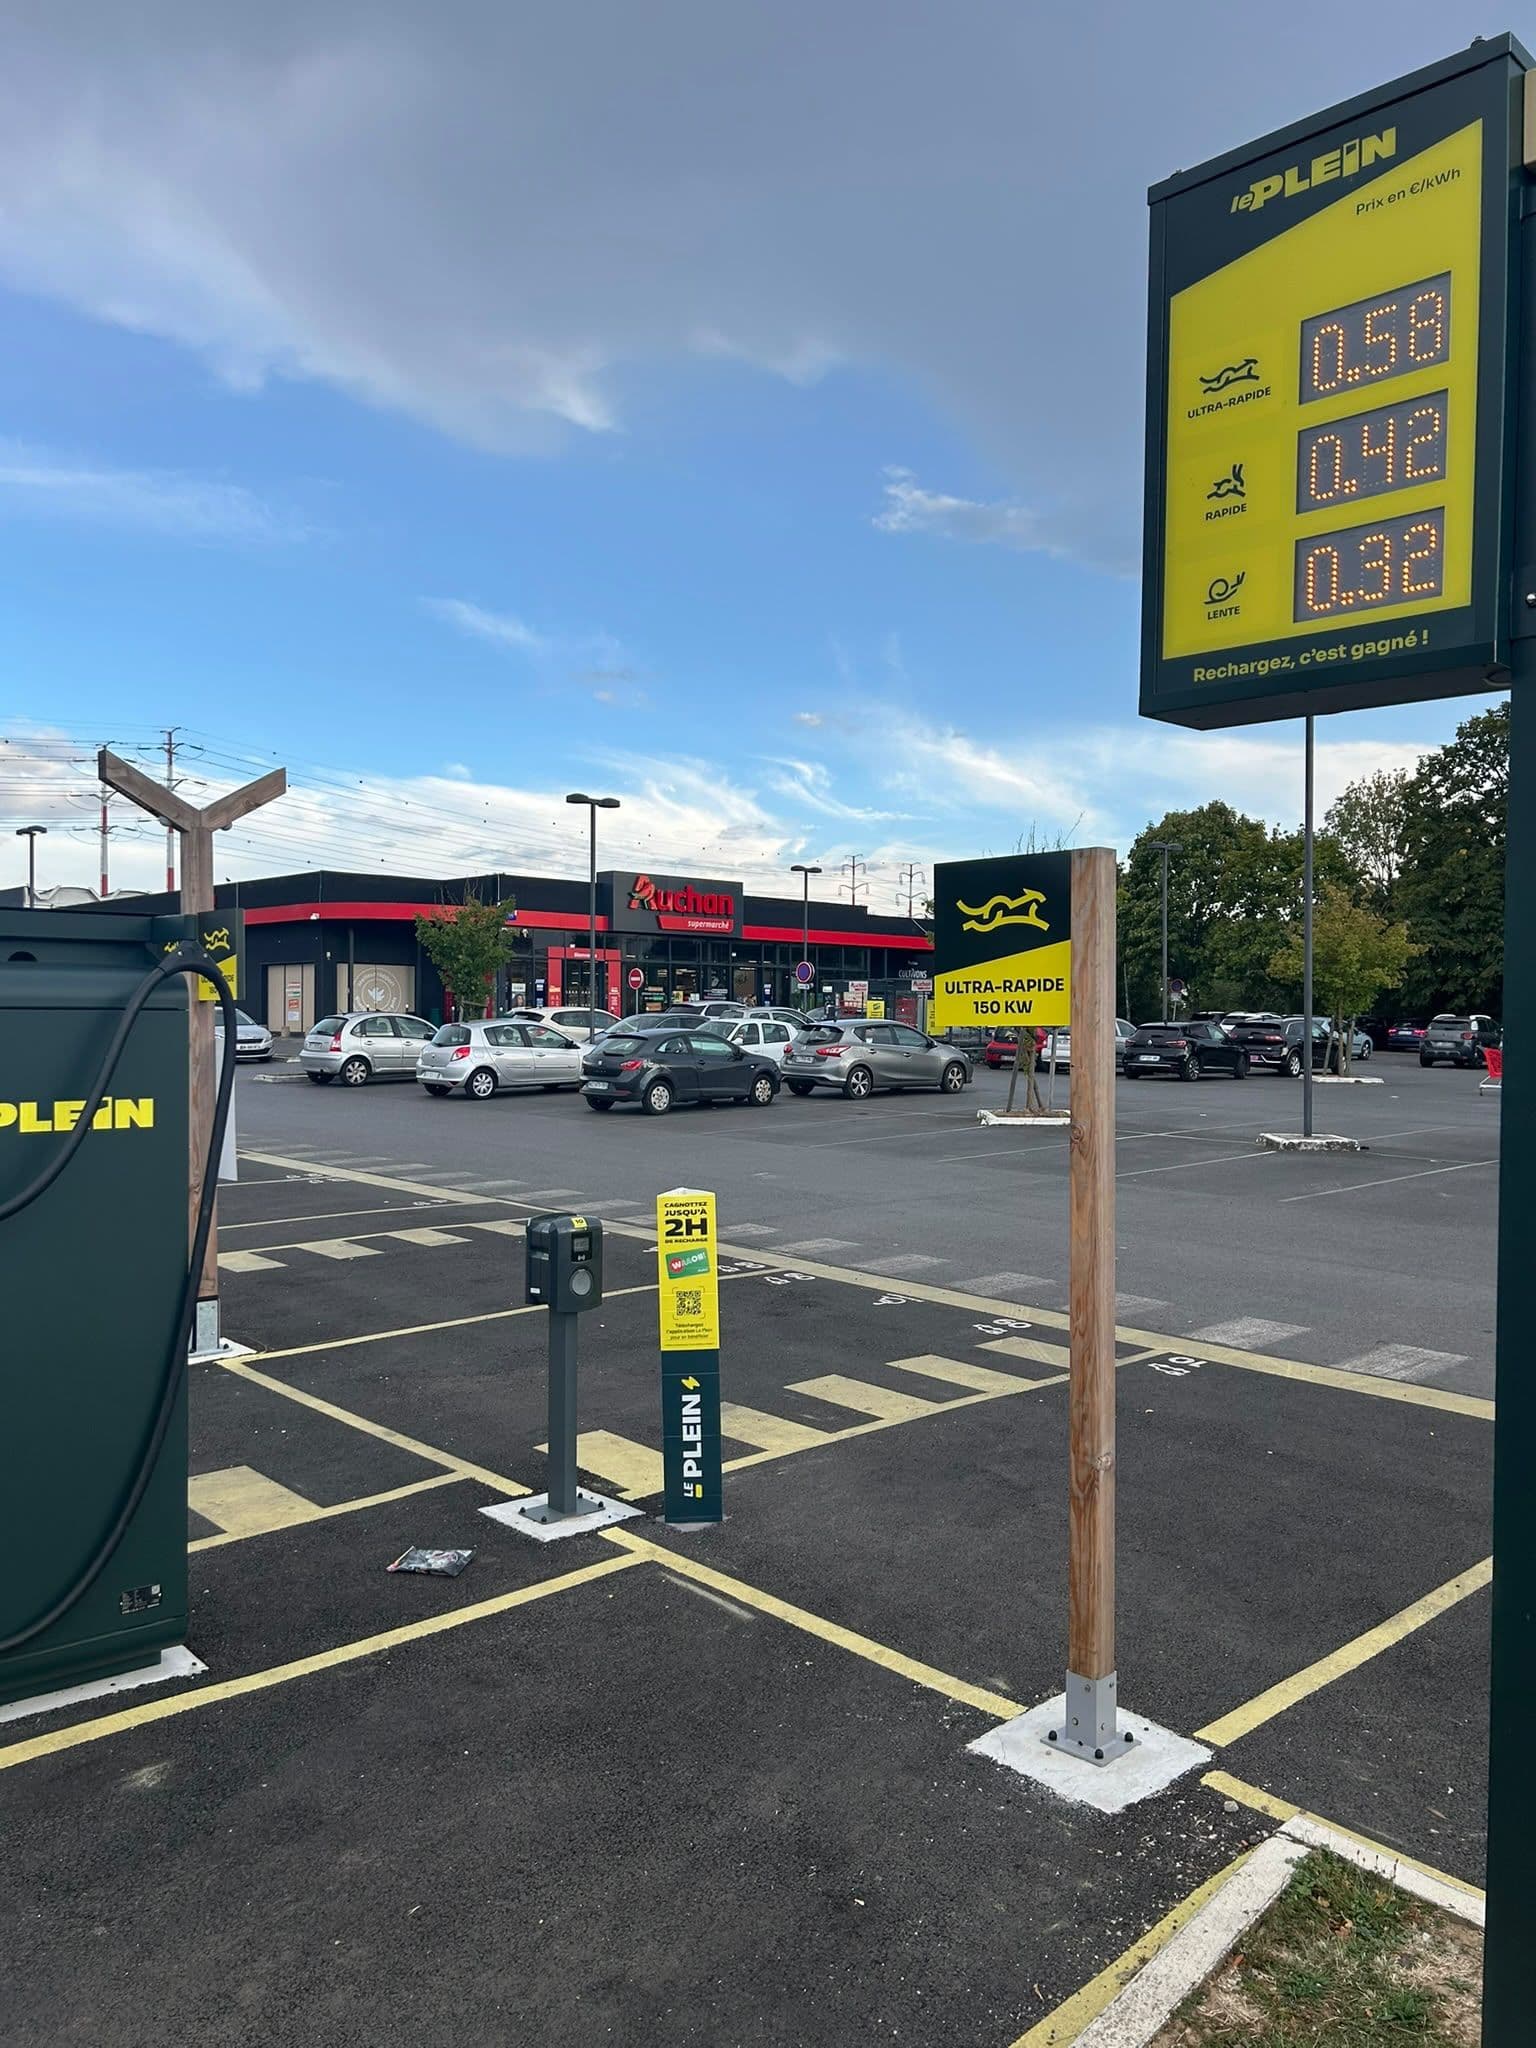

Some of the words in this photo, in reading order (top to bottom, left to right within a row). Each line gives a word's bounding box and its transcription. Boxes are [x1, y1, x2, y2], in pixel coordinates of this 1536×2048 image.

[1356, 198, 1384, 216] Prix
[1387, 189, 1406, 204] en
[1409, 168, 1461, 195] €/kWh
[1312, 293, 1442, 392] 0.58
[1187, 386, 1272, 420] ULTRA-RAPIDE
[1309, 406, 1441, 500] 0.42
[1204, 502, 1248, 522] RAPIDE
[1306, 522, 1437, 612] 0.32
[1206, 604, 1241, 621] LENTE
[1193, 655, 1296, 683] Rechargez,
[1299, 646, 1347, 665] c'est
[1351, 630, 1418, 661] gagné
[1421, 629, 1429, 645] !
[628, 874, 734, 915] Auchan
[687, 920, 730, 930] supermarché
[944, 978, 1065, 995] ULTRA-RAPIDE
[973, 1000, 1001, 1014] 150
[1004, 1000, 1033, 1014] KW
[664, 1207, 708, 1217] JUSQU'À
[665, 1218, 708, 1237] 2H
[681, 1394, 703, 1478] PLEIN
[683, 1481, 694, 1498] LE
